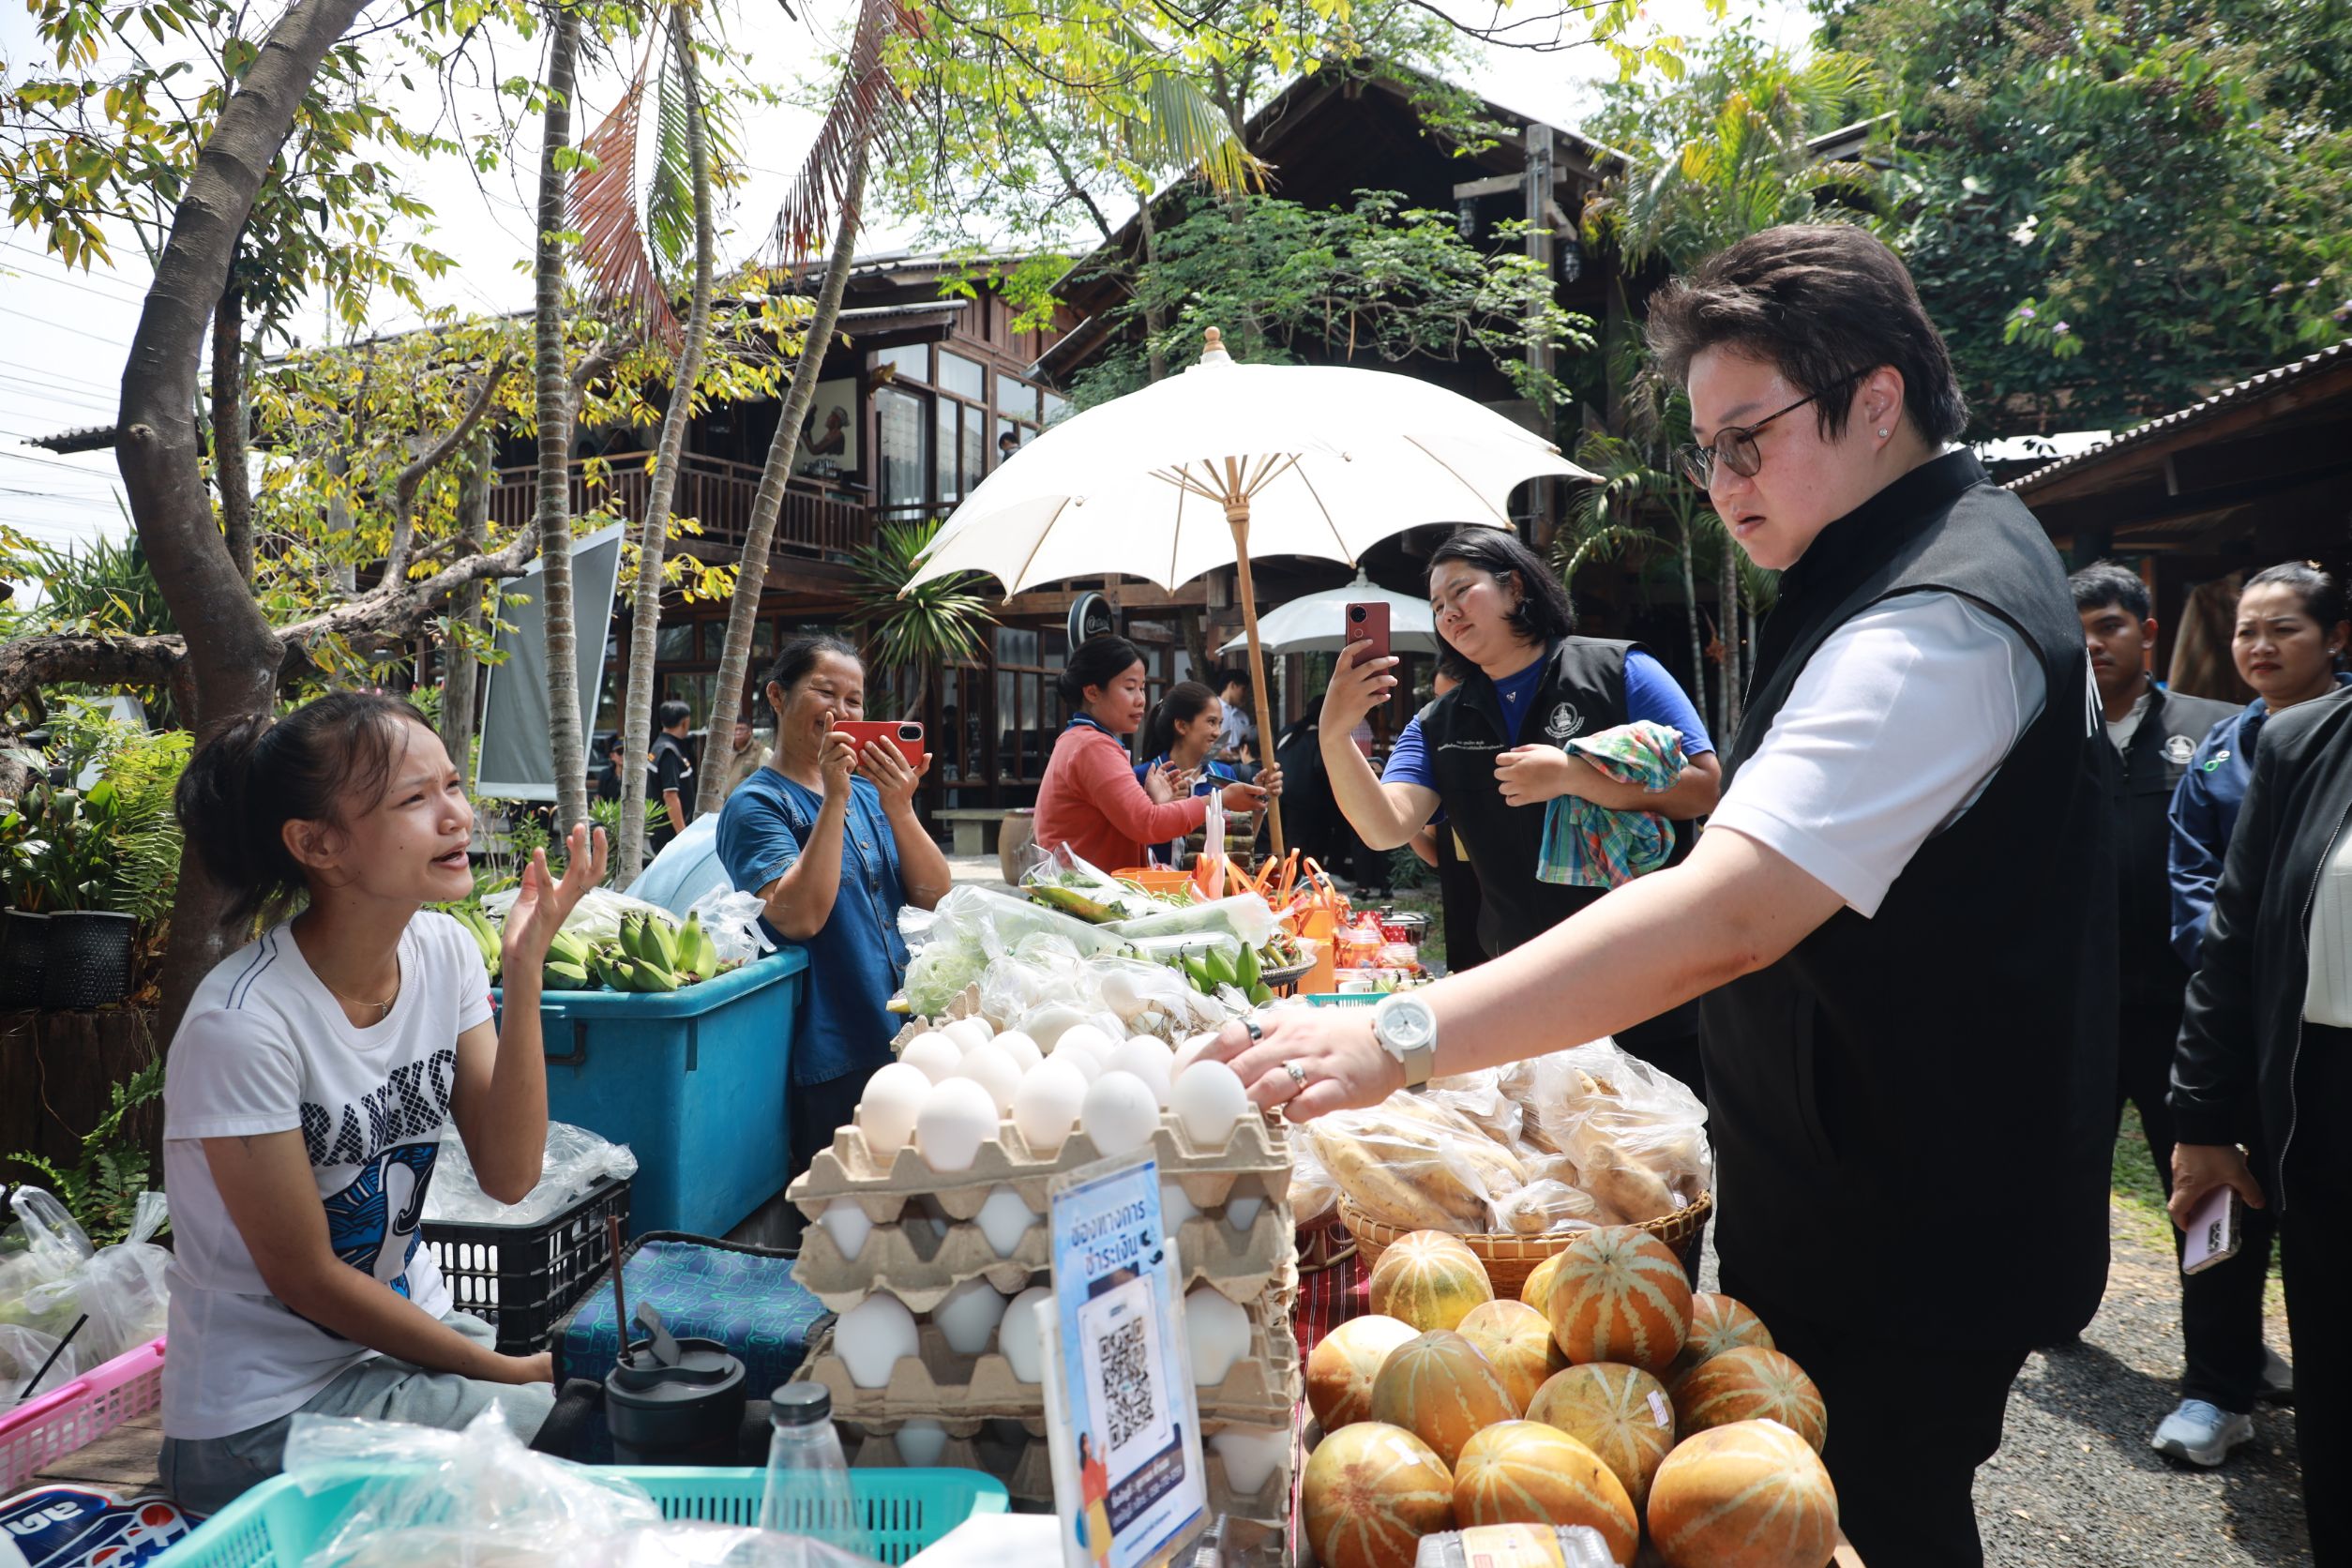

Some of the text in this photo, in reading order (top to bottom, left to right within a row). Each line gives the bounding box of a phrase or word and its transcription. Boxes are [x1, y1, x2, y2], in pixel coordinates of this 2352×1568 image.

[1071, 1200, 1145, 1247] ช่องทางการ
[1085, 1233, 1138, 1275] ชำระเงิน
